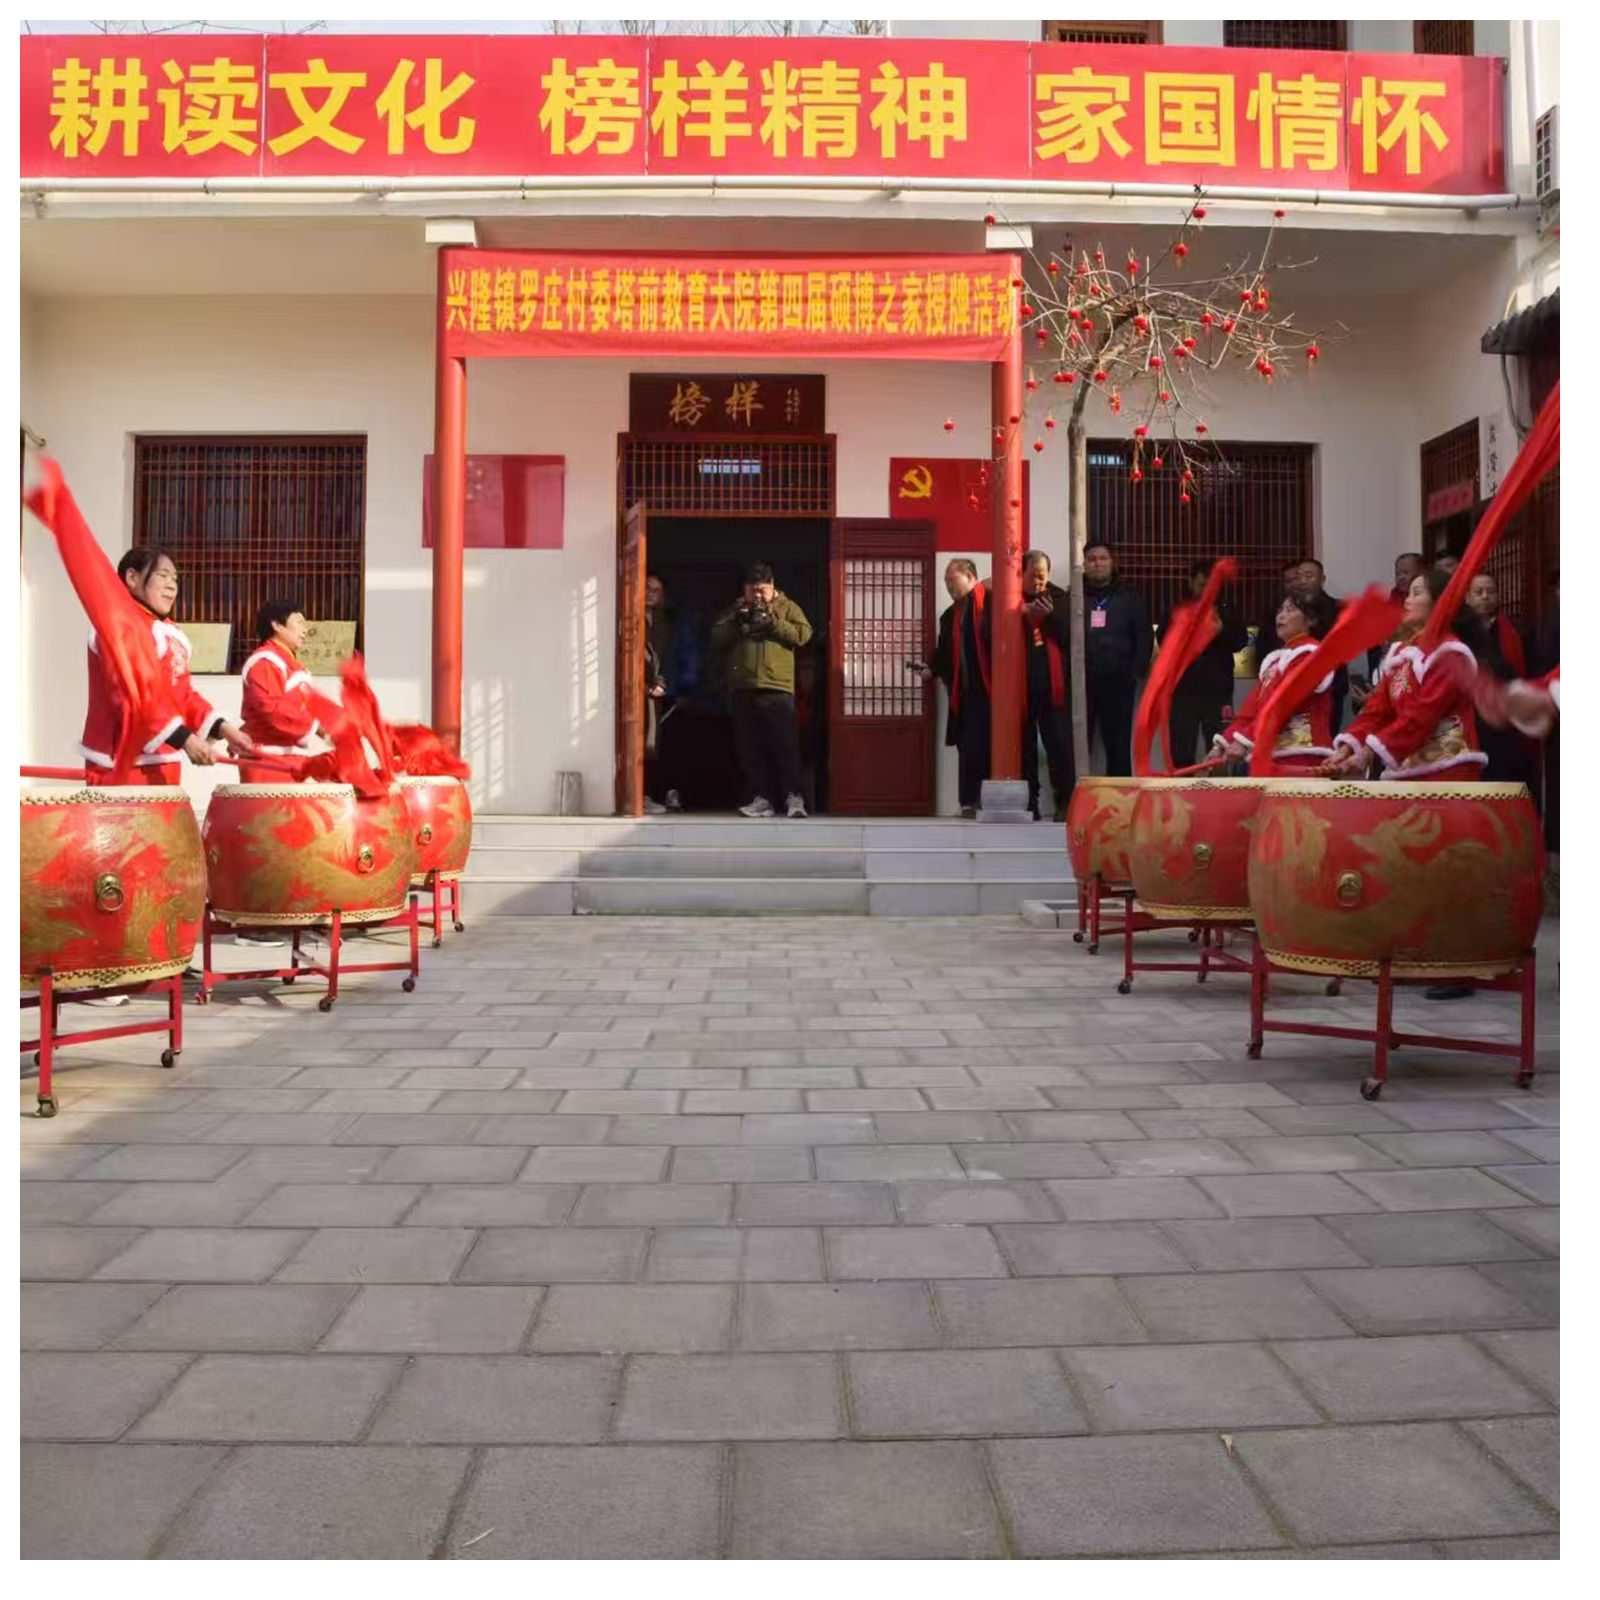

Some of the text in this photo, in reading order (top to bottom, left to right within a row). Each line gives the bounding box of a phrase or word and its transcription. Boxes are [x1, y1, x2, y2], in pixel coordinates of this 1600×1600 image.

[50, 58, 1449, 174] 耕读文化 榜样精神 家国情怀
[669, 380, 764, 426] 榜样
